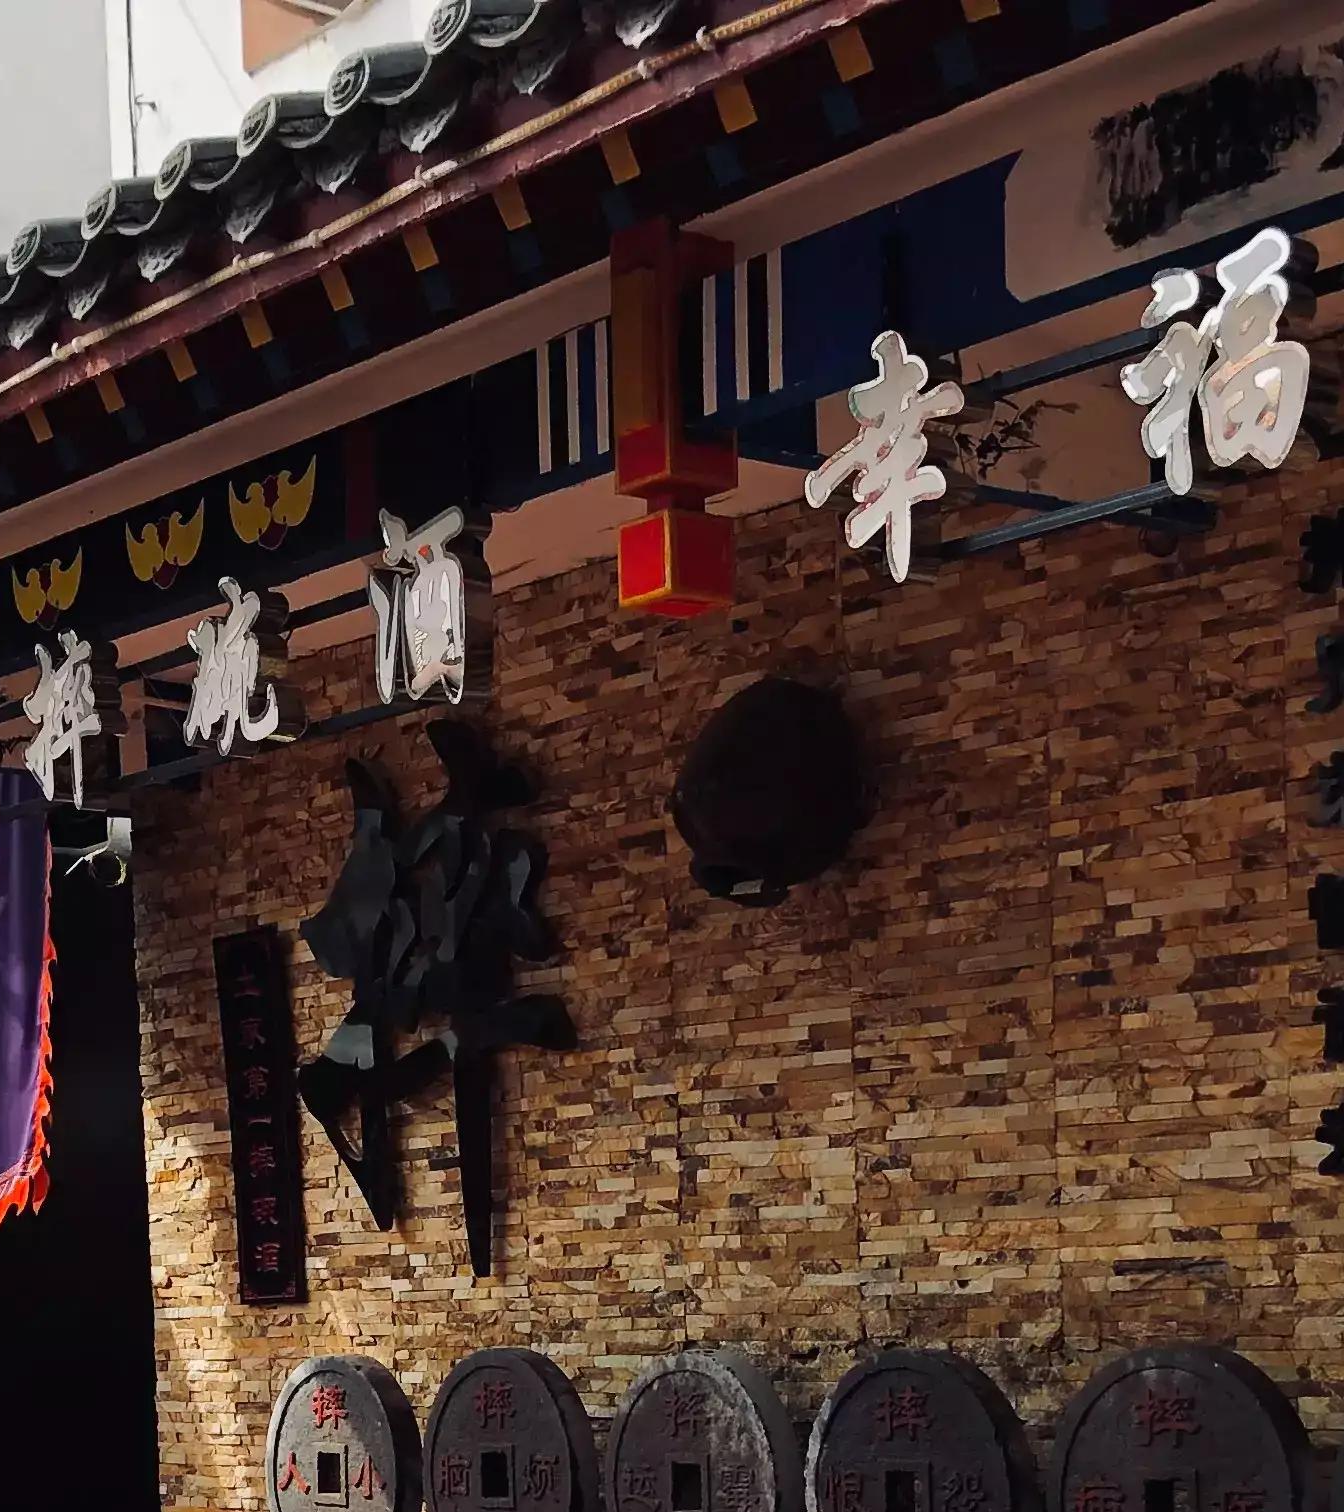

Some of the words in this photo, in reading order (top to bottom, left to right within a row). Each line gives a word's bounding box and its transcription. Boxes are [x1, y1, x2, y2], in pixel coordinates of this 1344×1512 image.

[312, 1384, 349, 1430] 摔
[474, 1381, 516, 1430] 摔
[872, 1385, 934, 1442] 摔
[1132, 1388, 1202, 1448] 摔
[279, 1453, 311, 1496] 人
[353, 1455, 387, 1500] 小
